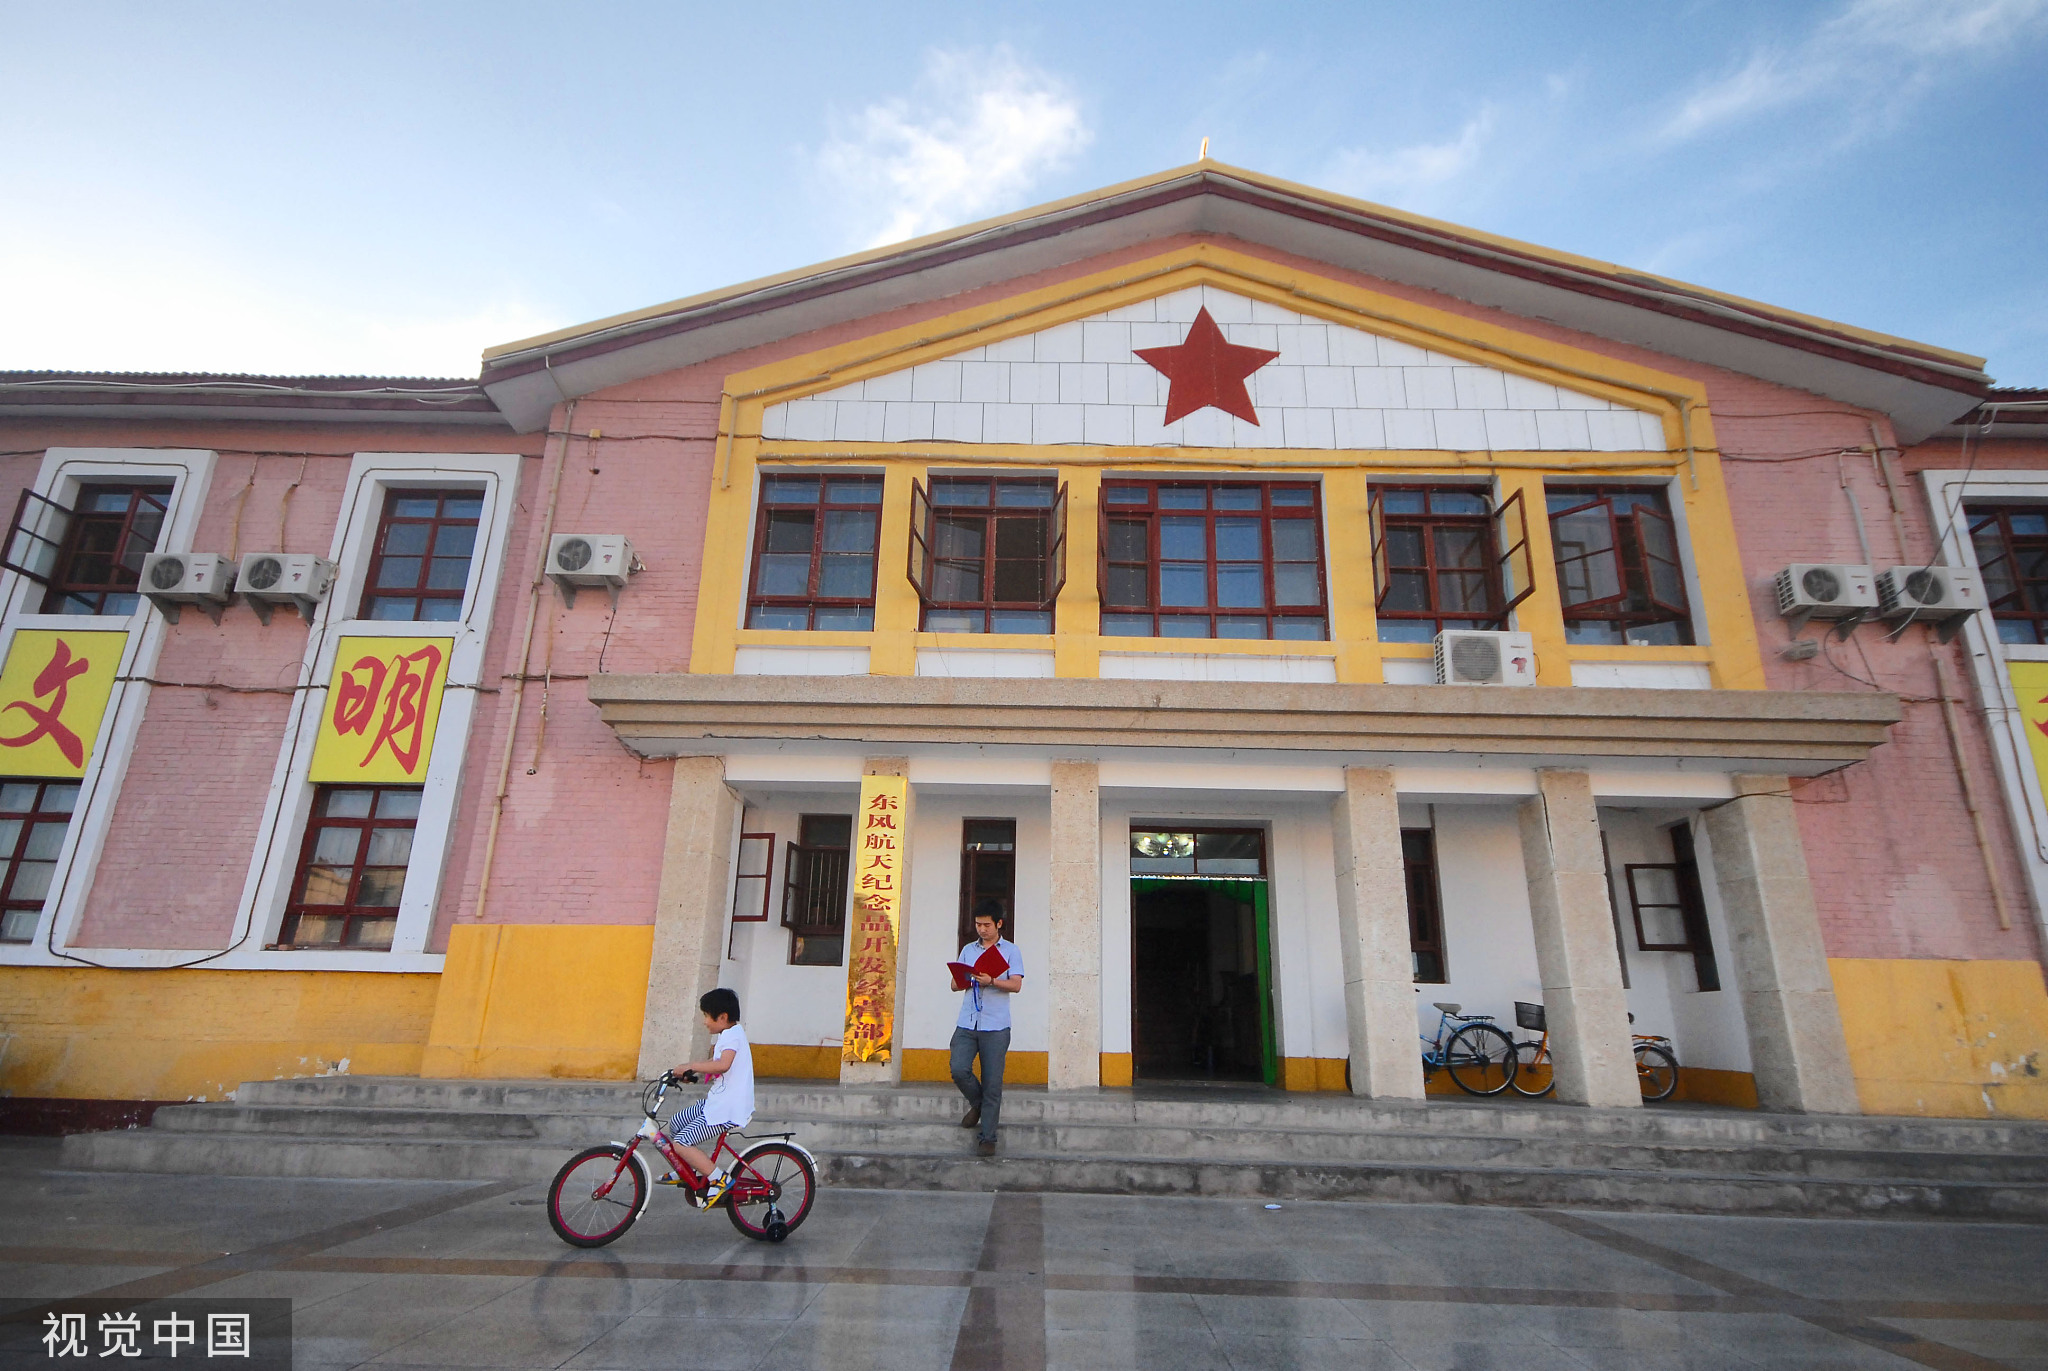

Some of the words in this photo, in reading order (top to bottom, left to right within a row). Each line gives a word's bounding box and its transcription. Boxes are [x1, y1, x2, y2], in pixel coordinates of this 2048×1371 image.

[0, 637, 89, 769] 文
[333, 644, 442, 775] 明
[854, 793, 898, 1040] 东风航天纪念品开发经营部
